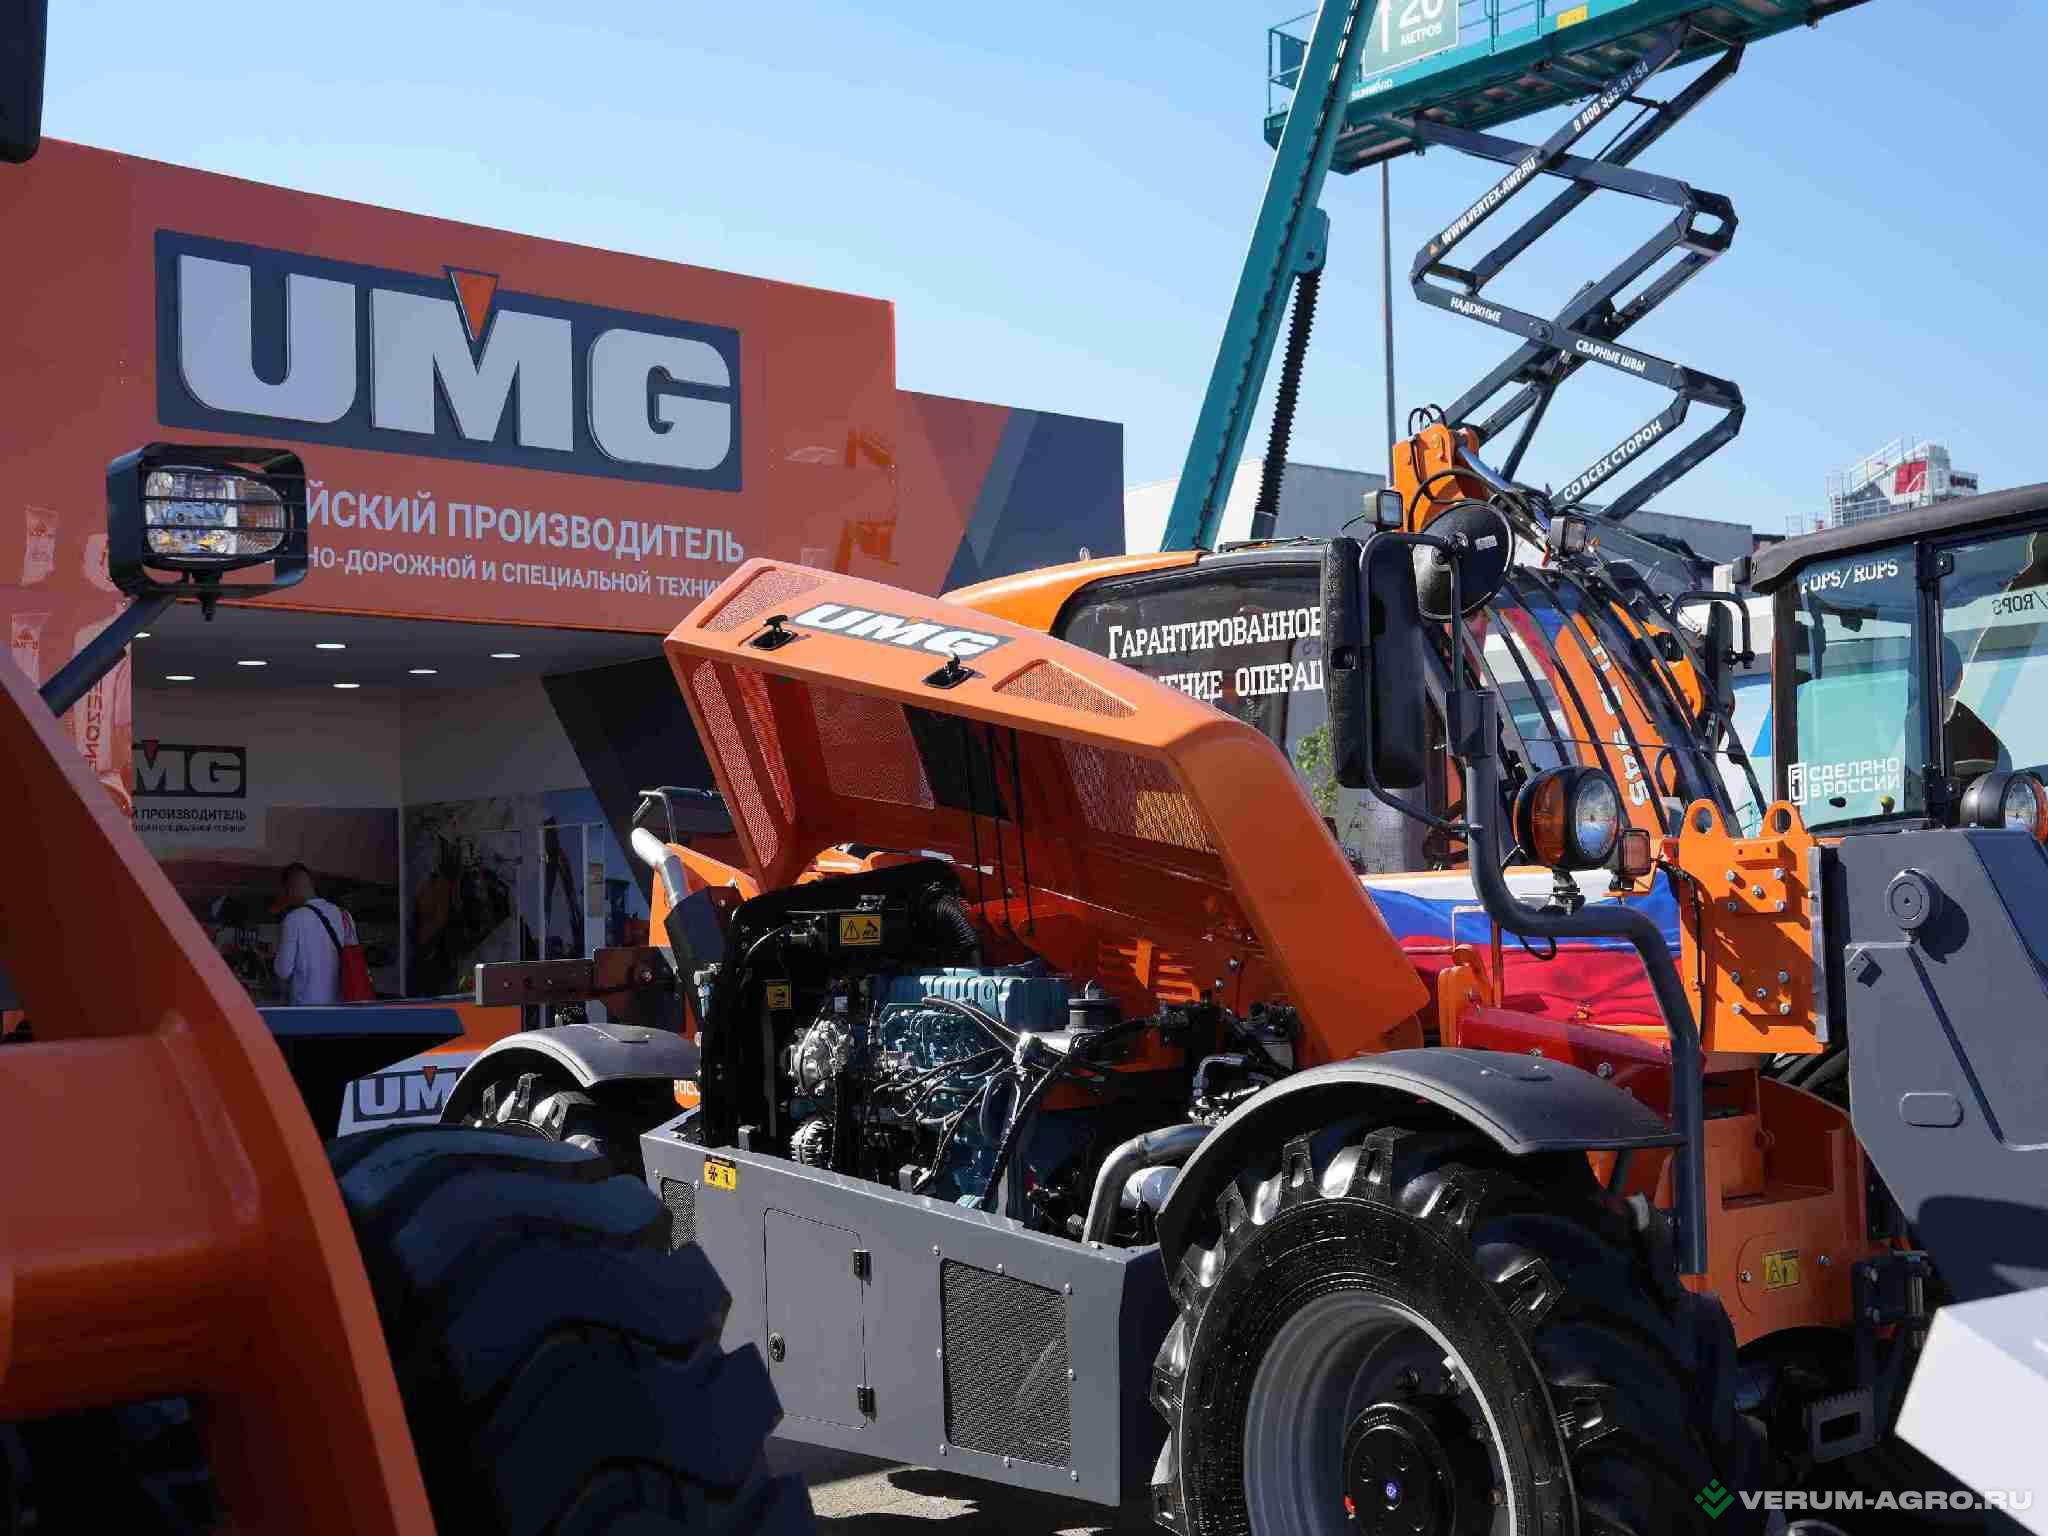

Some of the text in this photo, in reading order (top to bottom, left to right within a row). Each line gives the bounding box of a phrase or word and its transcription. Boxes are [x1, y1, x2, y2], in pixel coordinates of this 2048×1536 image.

[1441, 157, 1536, 245] WWW.VERTEX-AWP.RU
[177, 254, 731, 471] UMG
[1575, 339, 1646, 373] СВАРНЫЕ ШВЫ
[1563, 420, 1663, 501] СО ВСЕХ СТОРОН
[447, 501, 745, 563] ПРОИЗВОДИТЕЛЬ
[481, 560, 497, 580] И
[502, 562, 650, 595] СПЕЦИАЛЬНОЙ
[795, 603, 999, 656] UMG
[1809, 758, 1900, 781] СДЕЛАНО
[142, 808, 247, 821] ПРОИЗВОДИТЕЛЬ
